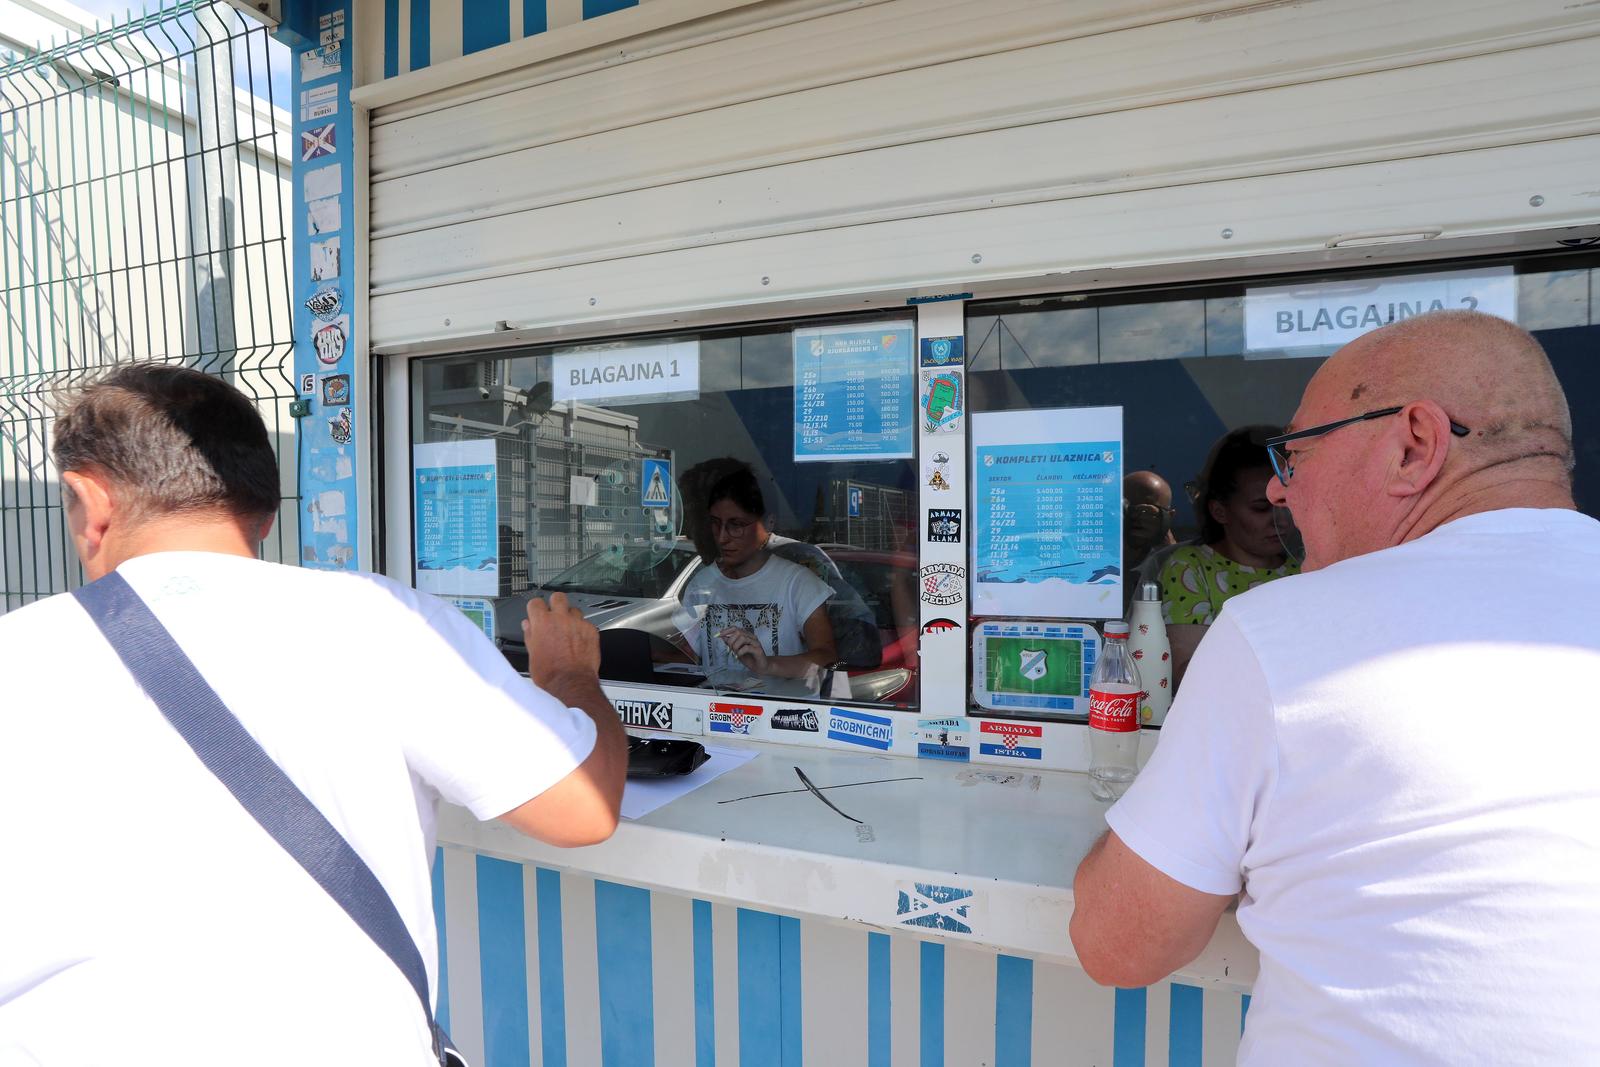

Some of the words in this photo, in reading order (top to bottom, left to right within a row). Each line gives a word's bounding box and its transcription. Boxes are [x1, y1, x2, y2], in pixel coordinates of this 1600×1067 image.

[1276, 299, 1445, 334] BLAGAJNA
[570, 362, 664, 386] BLAGAJNA
[670, 360, 680, 377] 1
[996, 455, 1046, 464] KOMPLETI
[1050, 454, 1100, 462] ULAZNICA
[930, 511, 960, 519] ARMADA
[920, 564, 965, 578] ARMADA
[613, 700, 652, 726] STAV
[988, 725, 1034, 734] ARMADA
[994, 748, 1026, 757] ISTRA
